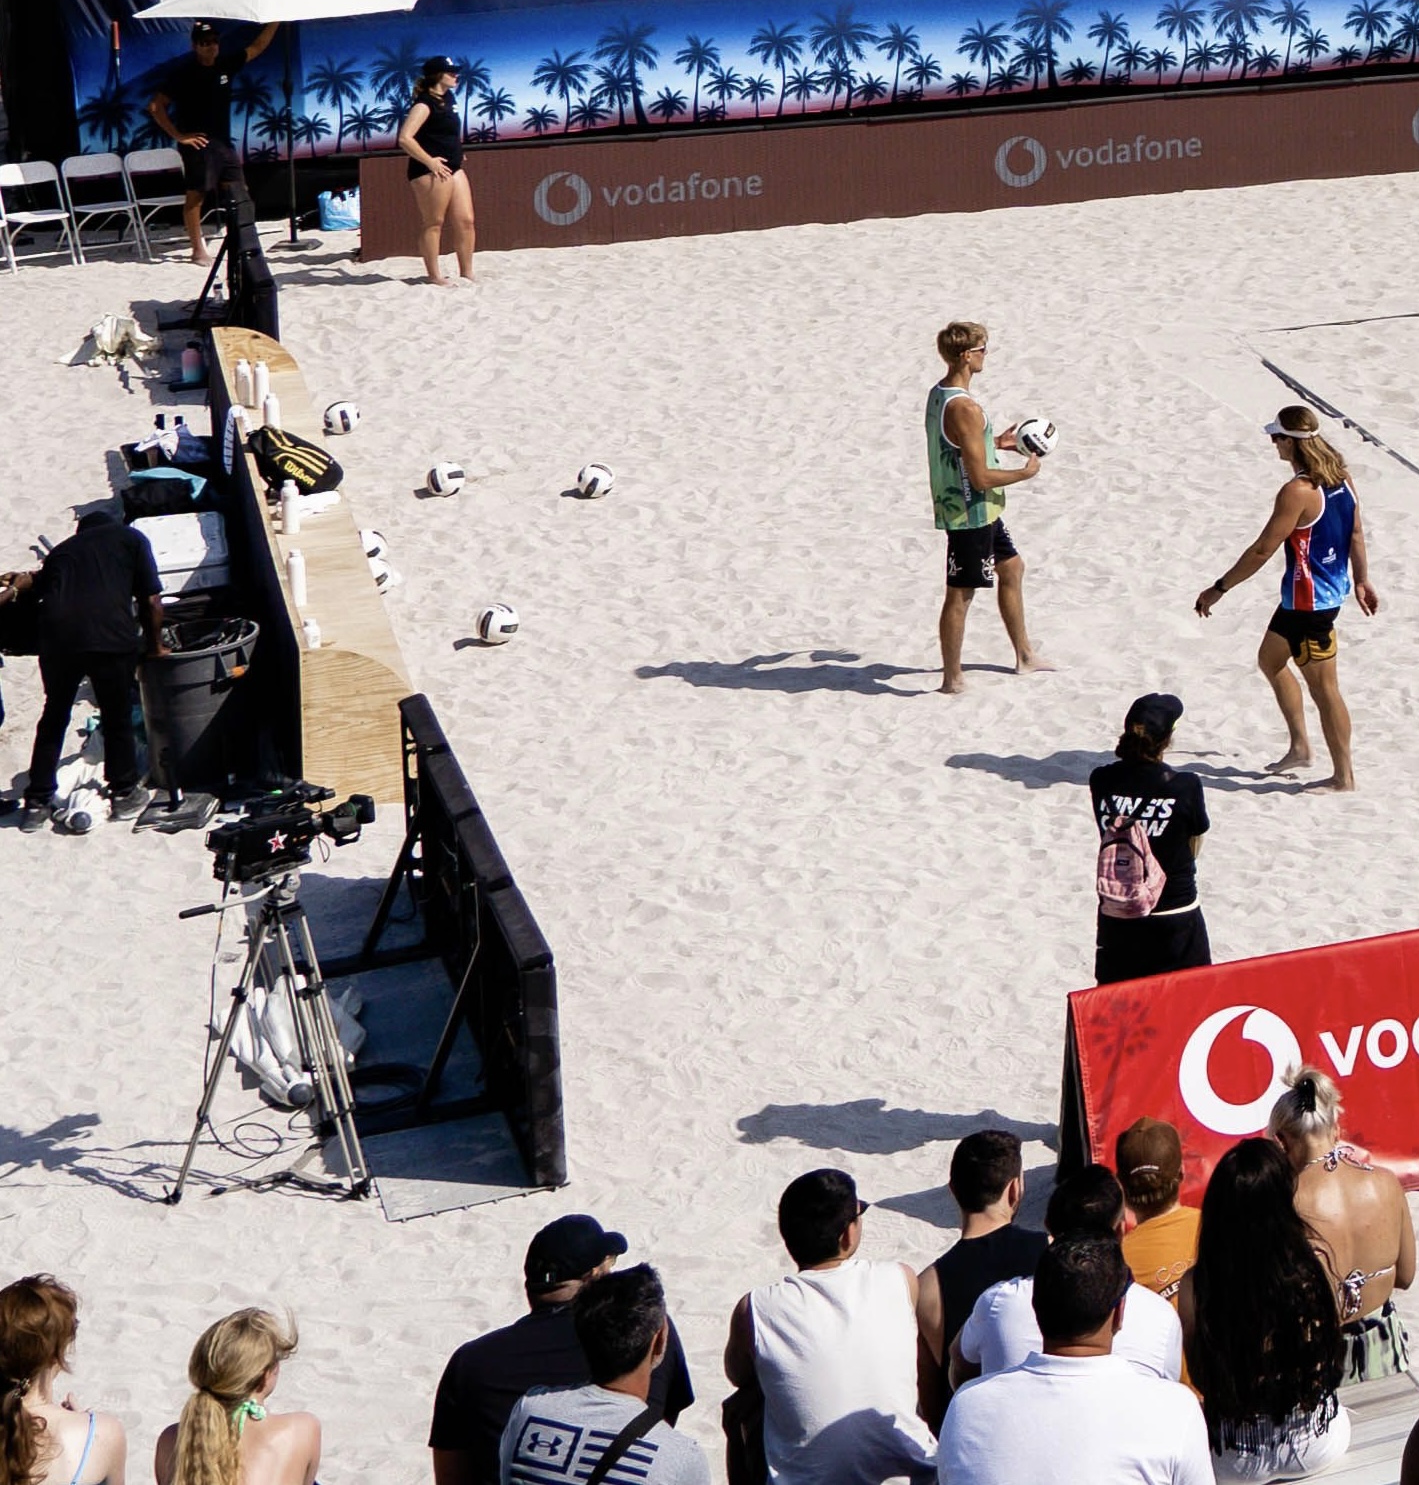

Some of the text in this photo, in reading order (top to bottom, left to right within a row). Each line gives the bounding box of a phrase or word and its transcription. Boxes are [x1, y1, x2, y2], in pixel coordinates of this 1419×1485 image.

[1056, 133, 1202, 171] vodafone
[602, 169, 763, 207] vodafone
[284, 460, 317, 487] Wilson
